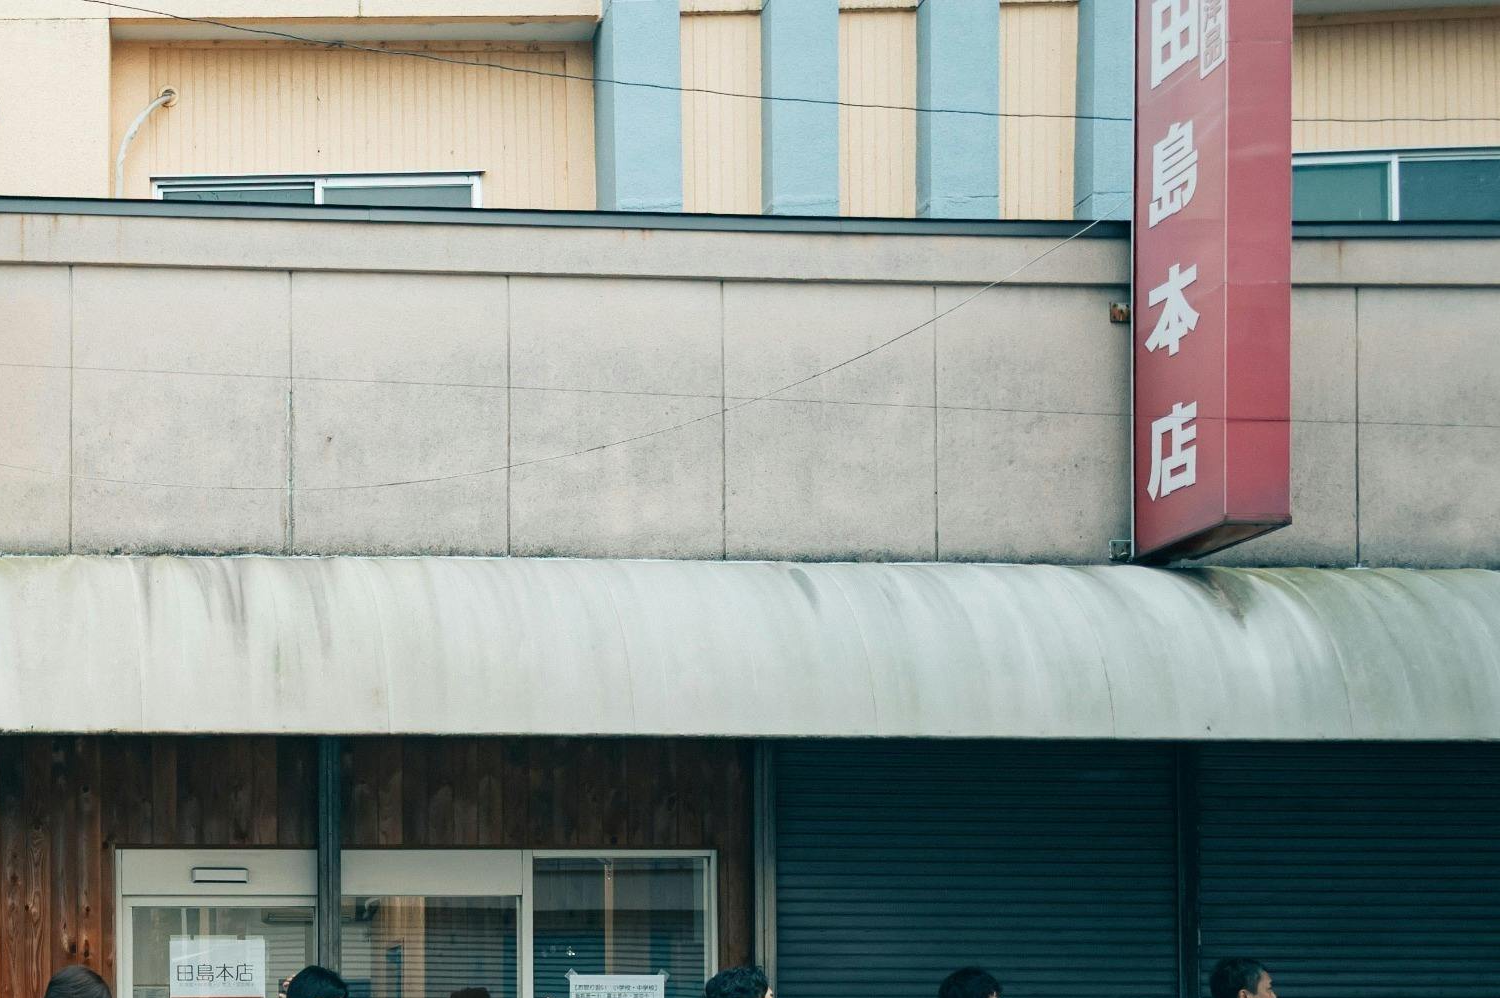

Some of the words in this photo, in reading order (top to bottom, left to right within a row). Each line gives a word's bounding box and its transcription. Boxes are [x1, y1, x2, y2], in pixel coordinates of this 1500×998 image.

[1144, 0, 1200, 501] 田島本店
[176, 963, 254, 983] 田島本店
